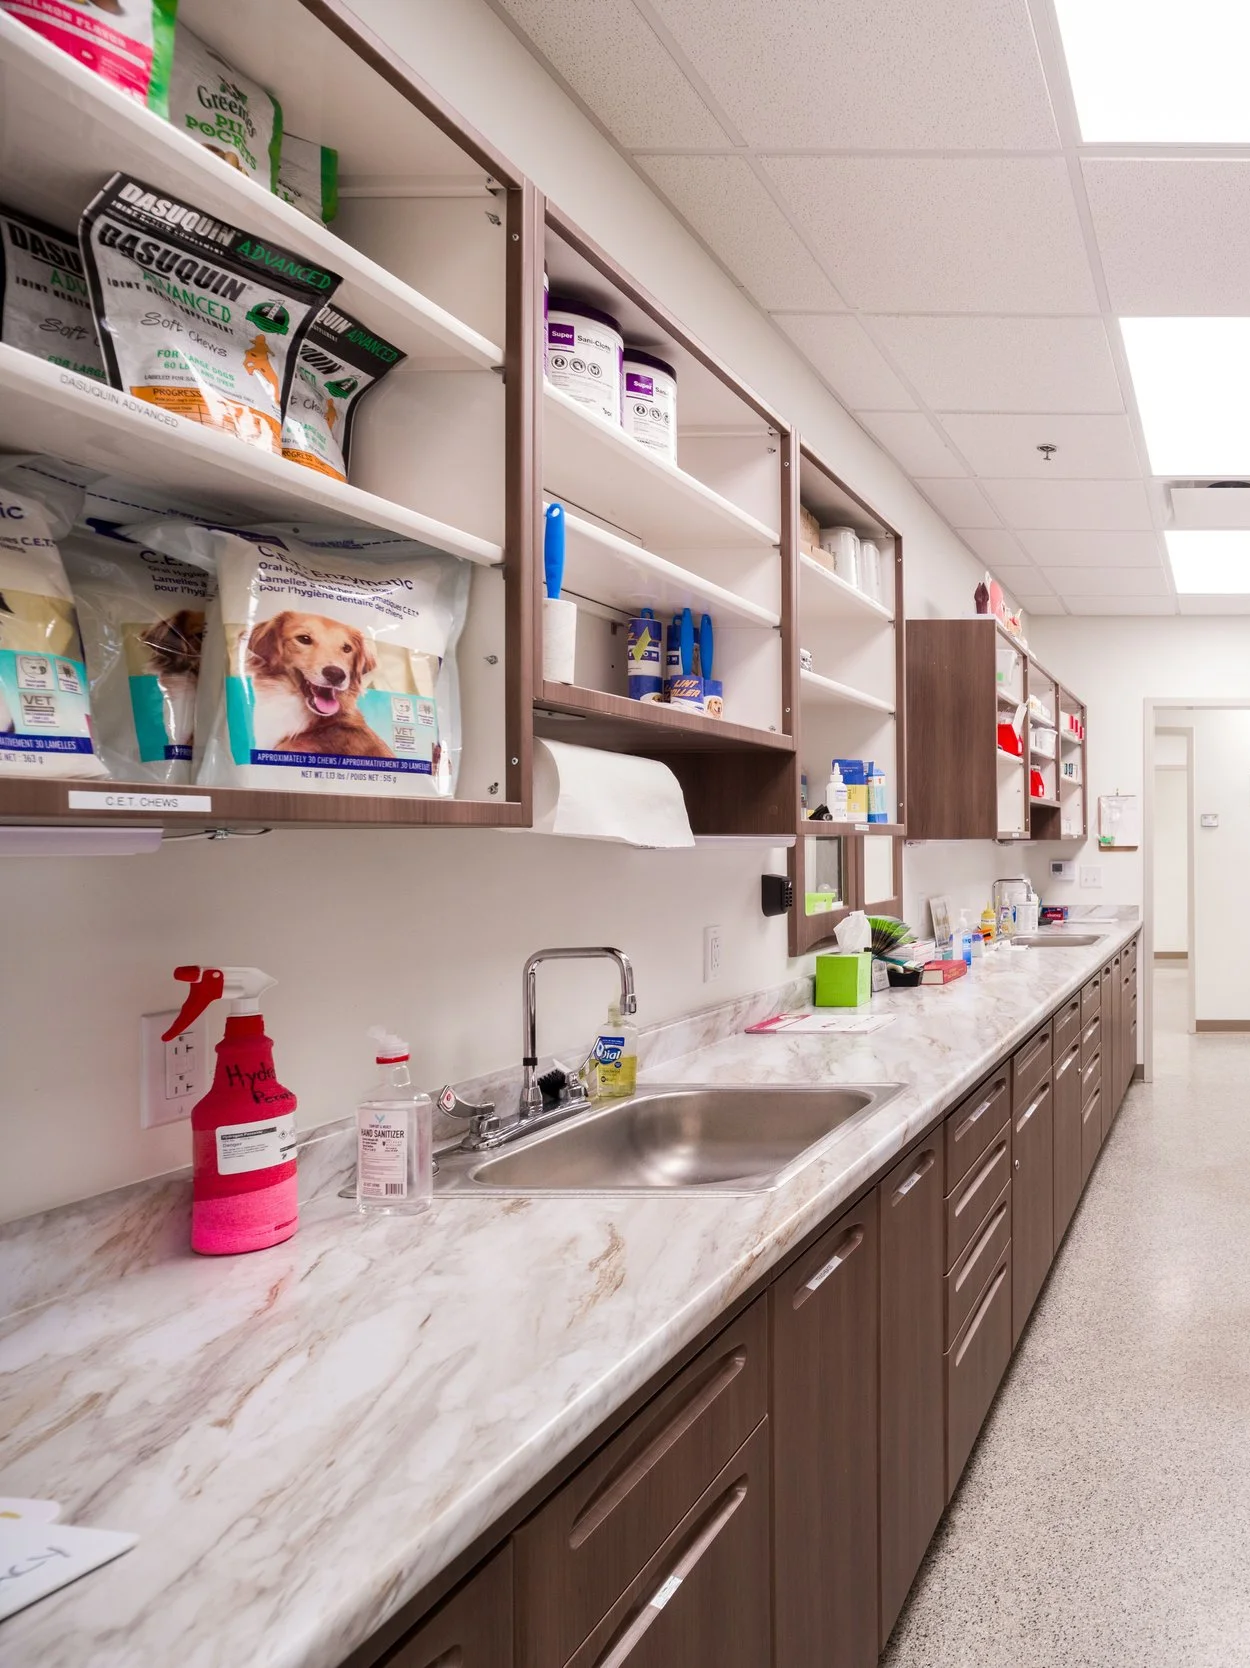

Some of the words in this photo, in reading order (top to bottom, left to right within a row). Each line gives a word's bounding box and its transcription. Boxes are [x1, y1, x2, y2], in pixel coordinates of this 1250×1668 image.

[118, 181, 238, 248] DASUQUIN
[235, 240, 332, 290] ADVANCED
[97, 222, 247, 303] DASUQUIN
[107, 277, 141, 290] JOINT
[39, 317, 89, 341] Soft
[140, 311, 184, 331] Soft
[188, 330, 228, 358] Chews
[345, 326, 399, 364] ADVANCED
[551, 330, 573, 340] Super
[576, 334, 612, 352] Sani-Cloth
[156, 349, 180, 359] FOR
[163, 361, 176, 370] 60
[144, 374, 171, 382] LABELED
[633, 379, 653, 390] Super
[60, 373, 120, 405] DASUQUIN
[121, 397, 179, 429] ADVANCED
[258, 561, 283, 572] Oral
[151, 574, 200, 588] Lamelles
[258, 574, 307, 588] Lamelles
[311, 568, 414, 591] Enzymatic
[154, 584, 178, 593] pour
[258, 584, 286, 594] pour
[287, 586, 335, 602] l'hygiène
[336, 593, 374, 608] dentaire
[374, 602, 385, 611] des
[385, 607, 404, 620] chiens
[673, 679, 700, 688] LINT
[23, 695, 53, 706] VET
[395, 726, 415, 736] VET
[35, 739, 44, 749] 30
[44, 740, 77, 750] LAMELLES
[3, 753, 18, 763] NET
[22, 754, 37, 763] 363
[257, 752, 307, 764] APPROXIMATELY
[308, 755, 316, 764] 30
[317, 756, 338, 765] CHEWS
[342, 757, 400, 769] APPROXIMATIVEMENT
[400, 761, 409, 769] 30
[301, 770, 313, 778] NET
[314, 771, 325, 779] WT.
[325, 771, 336, 779] 1.13
[336, 772, 346, 780] lbs
[350, 772, 367, 781] POIDS
[368, 773, 379, 782] NET
[383, 774, 392, 782] 515
[105, 796, 137, 807] C.E.T.
[139, 797, 179, 808] CHEWS
[360, 1128, 374, 1138] HAND
[373, 1129, 405, 1139] SANITIZER
[222, 1141, 243, 1149] Danger
